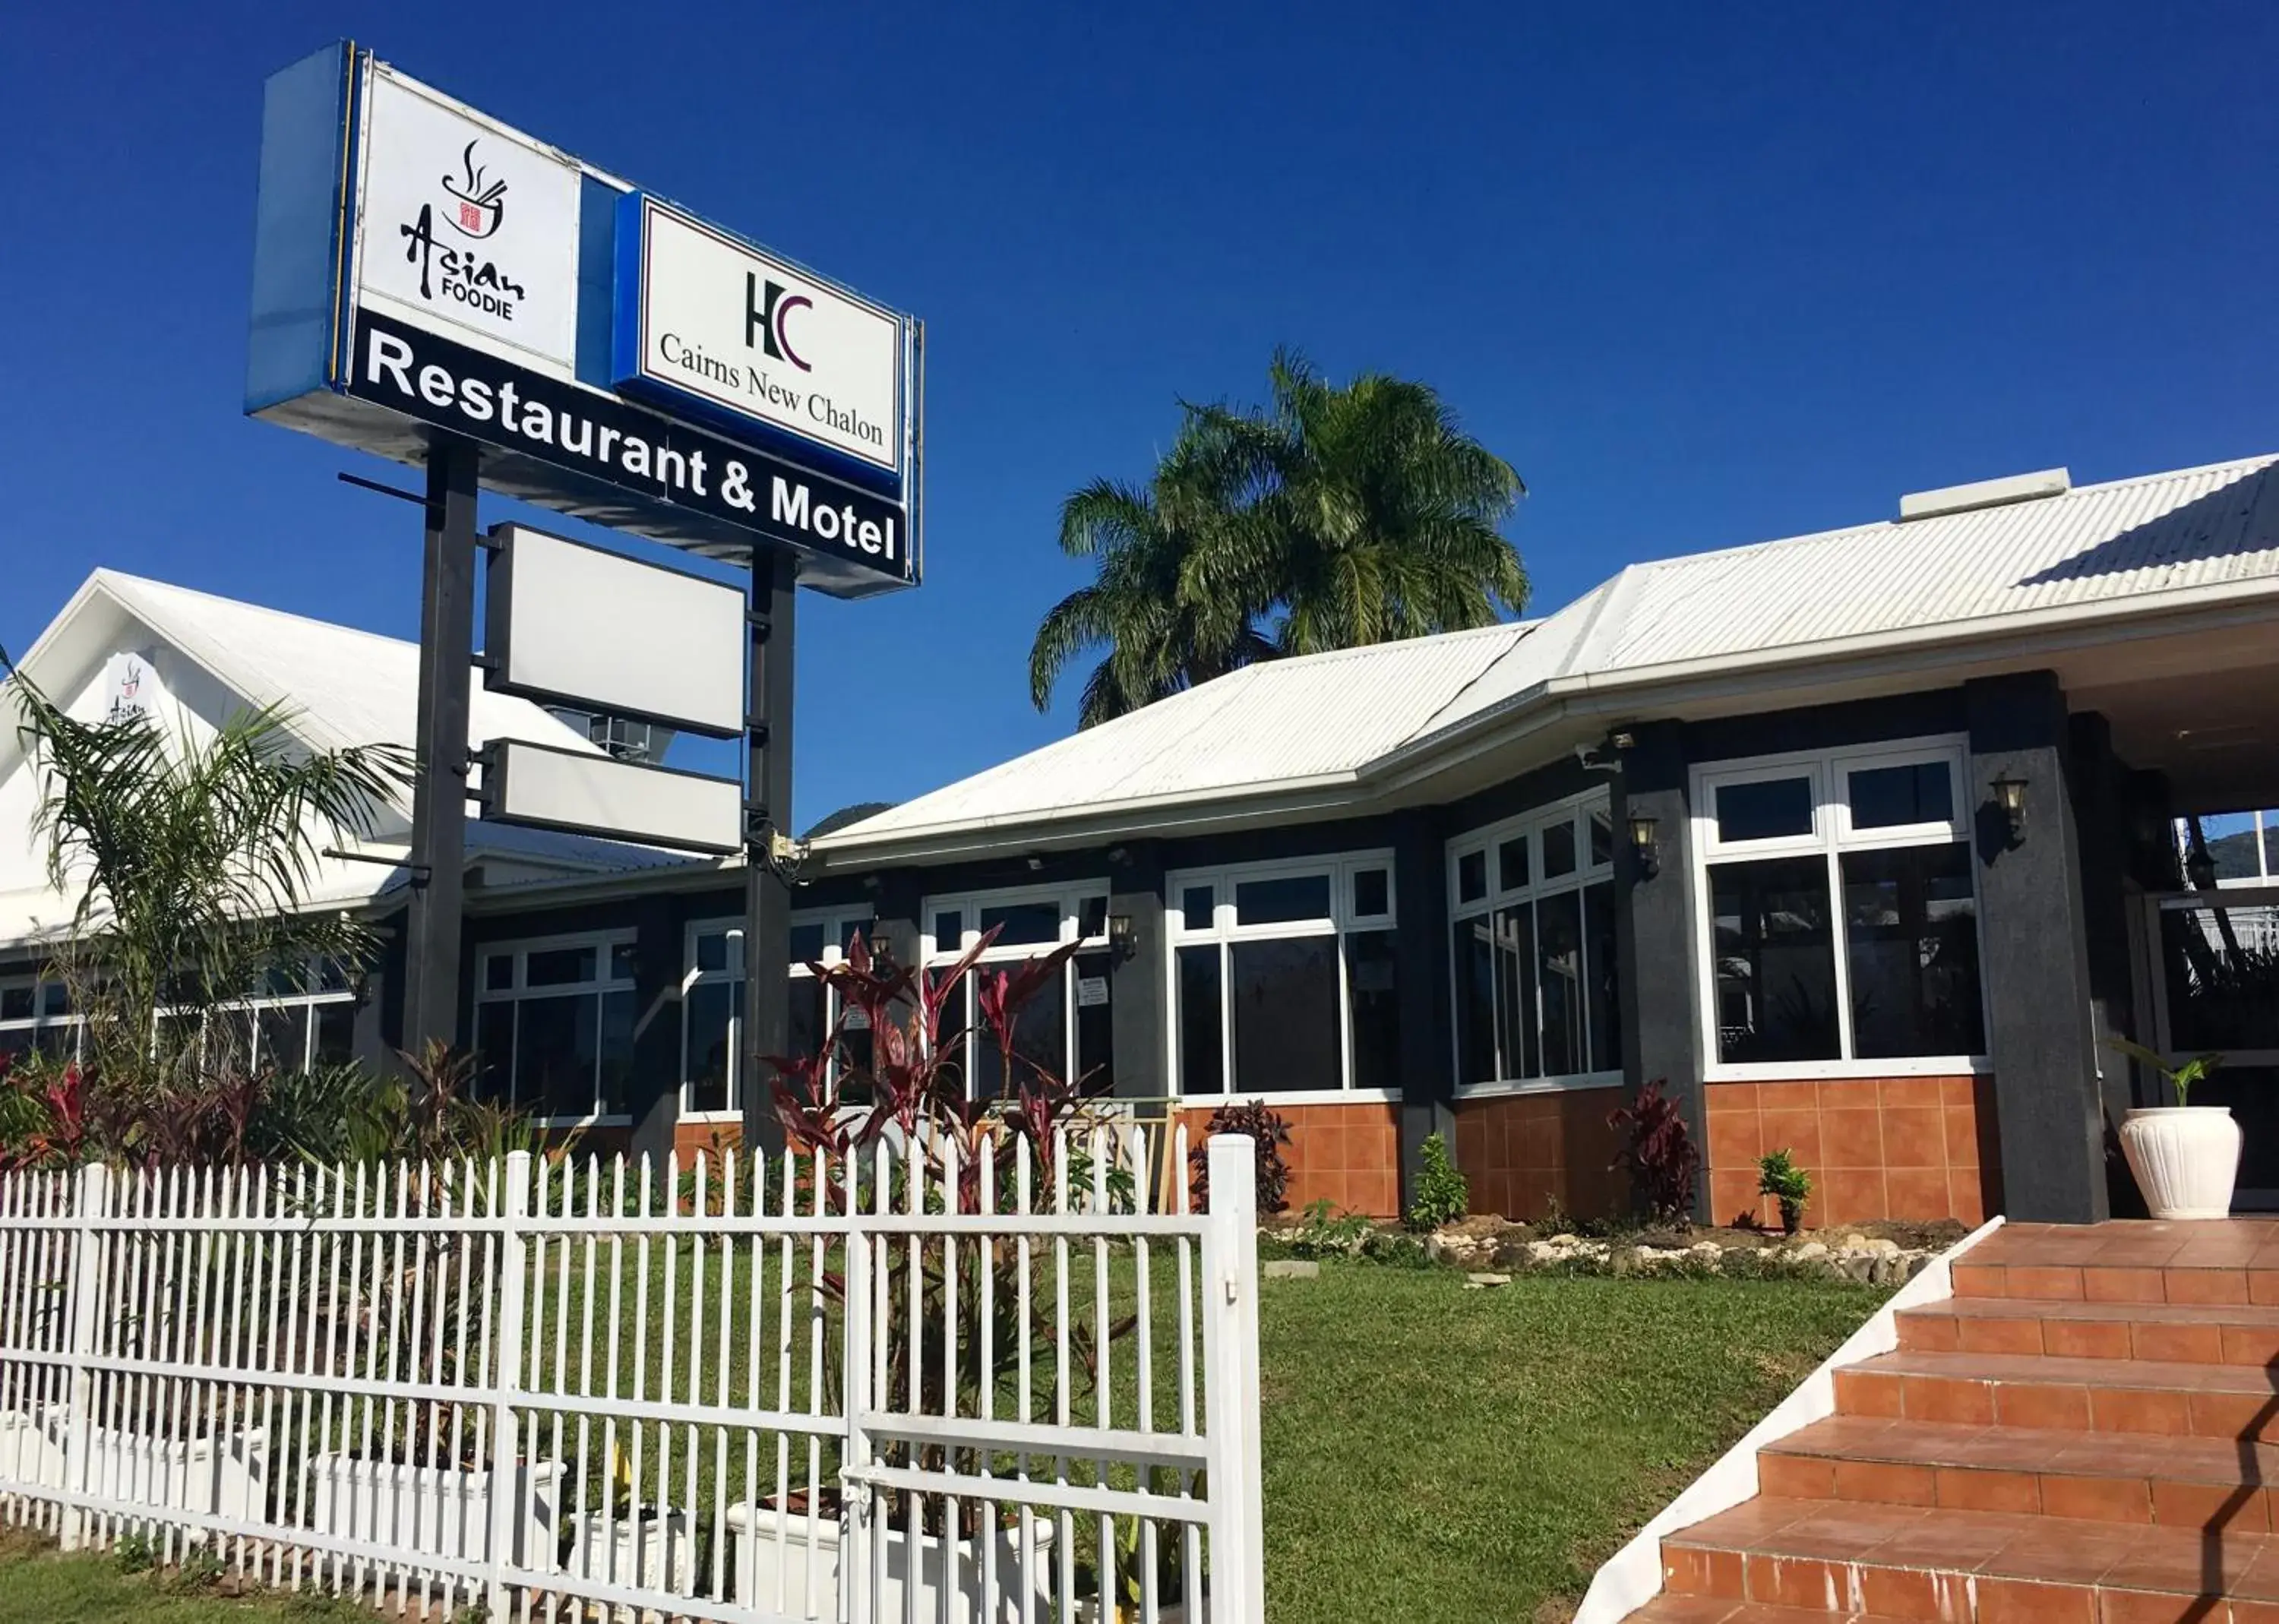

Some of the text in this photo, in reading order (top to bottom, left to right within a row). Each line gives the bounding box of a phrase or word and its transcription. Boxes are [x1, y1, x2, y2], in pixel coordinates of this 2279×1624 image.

[401, 204, 524, 300] Asian
[441, 277, 513, 321] FOODIE
[746, 271, 813, 373] HC
[660, 333, 883, 446] Cairns New Chalon
[368, 328, 894, 560] Restaurant & Motel
